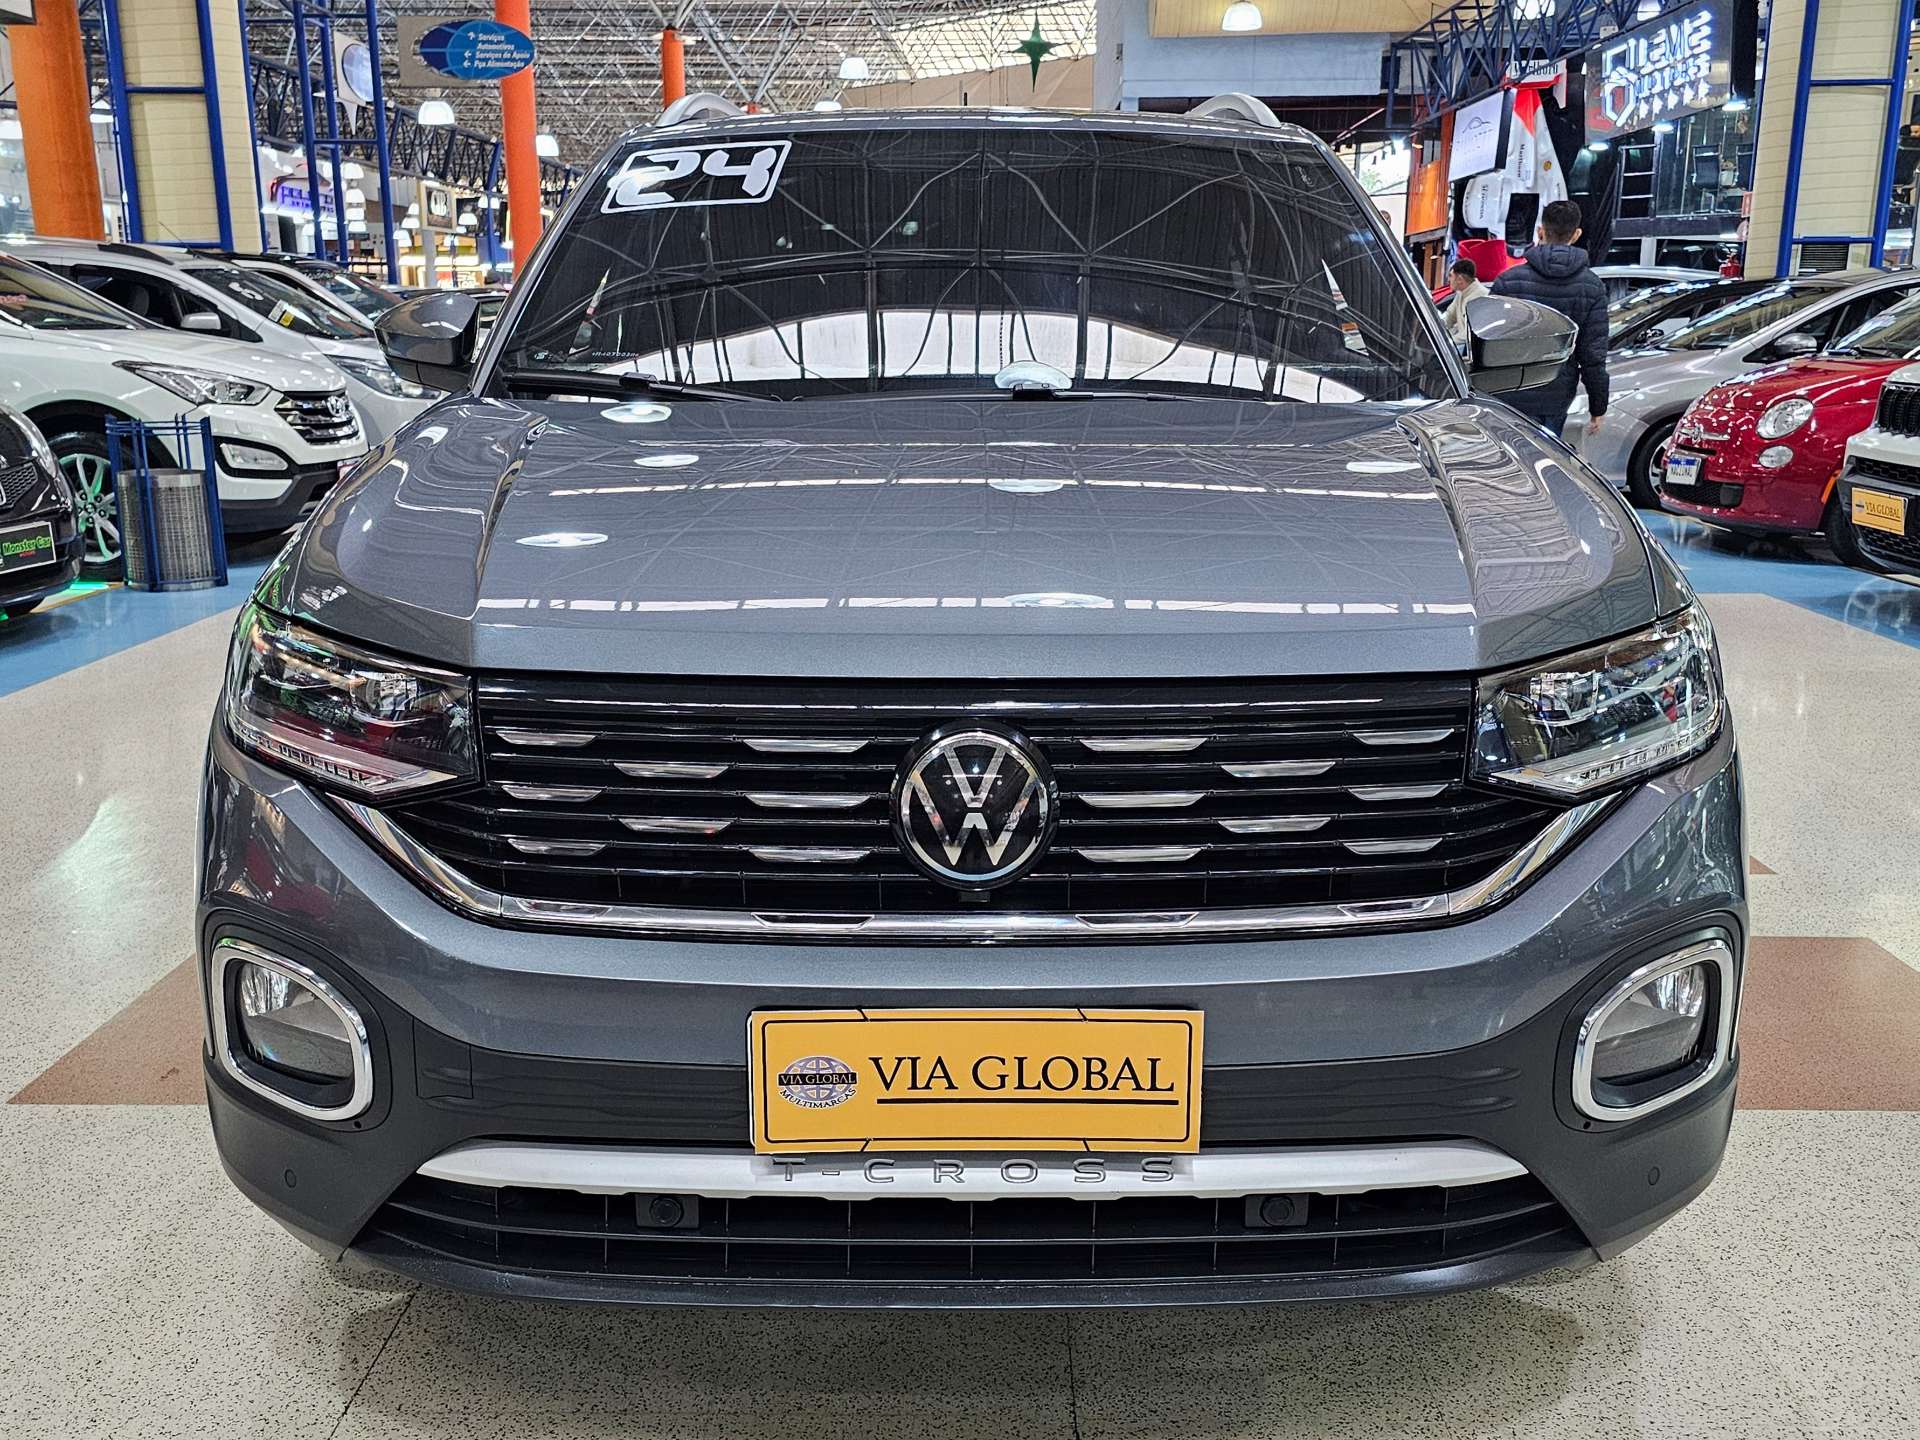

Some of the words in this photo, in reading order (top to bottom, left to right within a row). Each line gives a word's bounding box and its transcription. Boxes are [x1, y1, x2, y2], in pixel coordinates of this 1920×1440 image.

[615, 147, 777, 206] 24
[2, 540, 36, 556] Monster
[780, 1074, 803, 1085] VIA
[805, 1073, 856, 1085] GLOBAL
[868, 1056, 959, 1092] VIA
[971, 1056, 1175, 1092] GLOBAL
[780, 1088, 857, 1109] MULTIMARCAS
[772, 1157, 1176, 1184] T-CROSS
